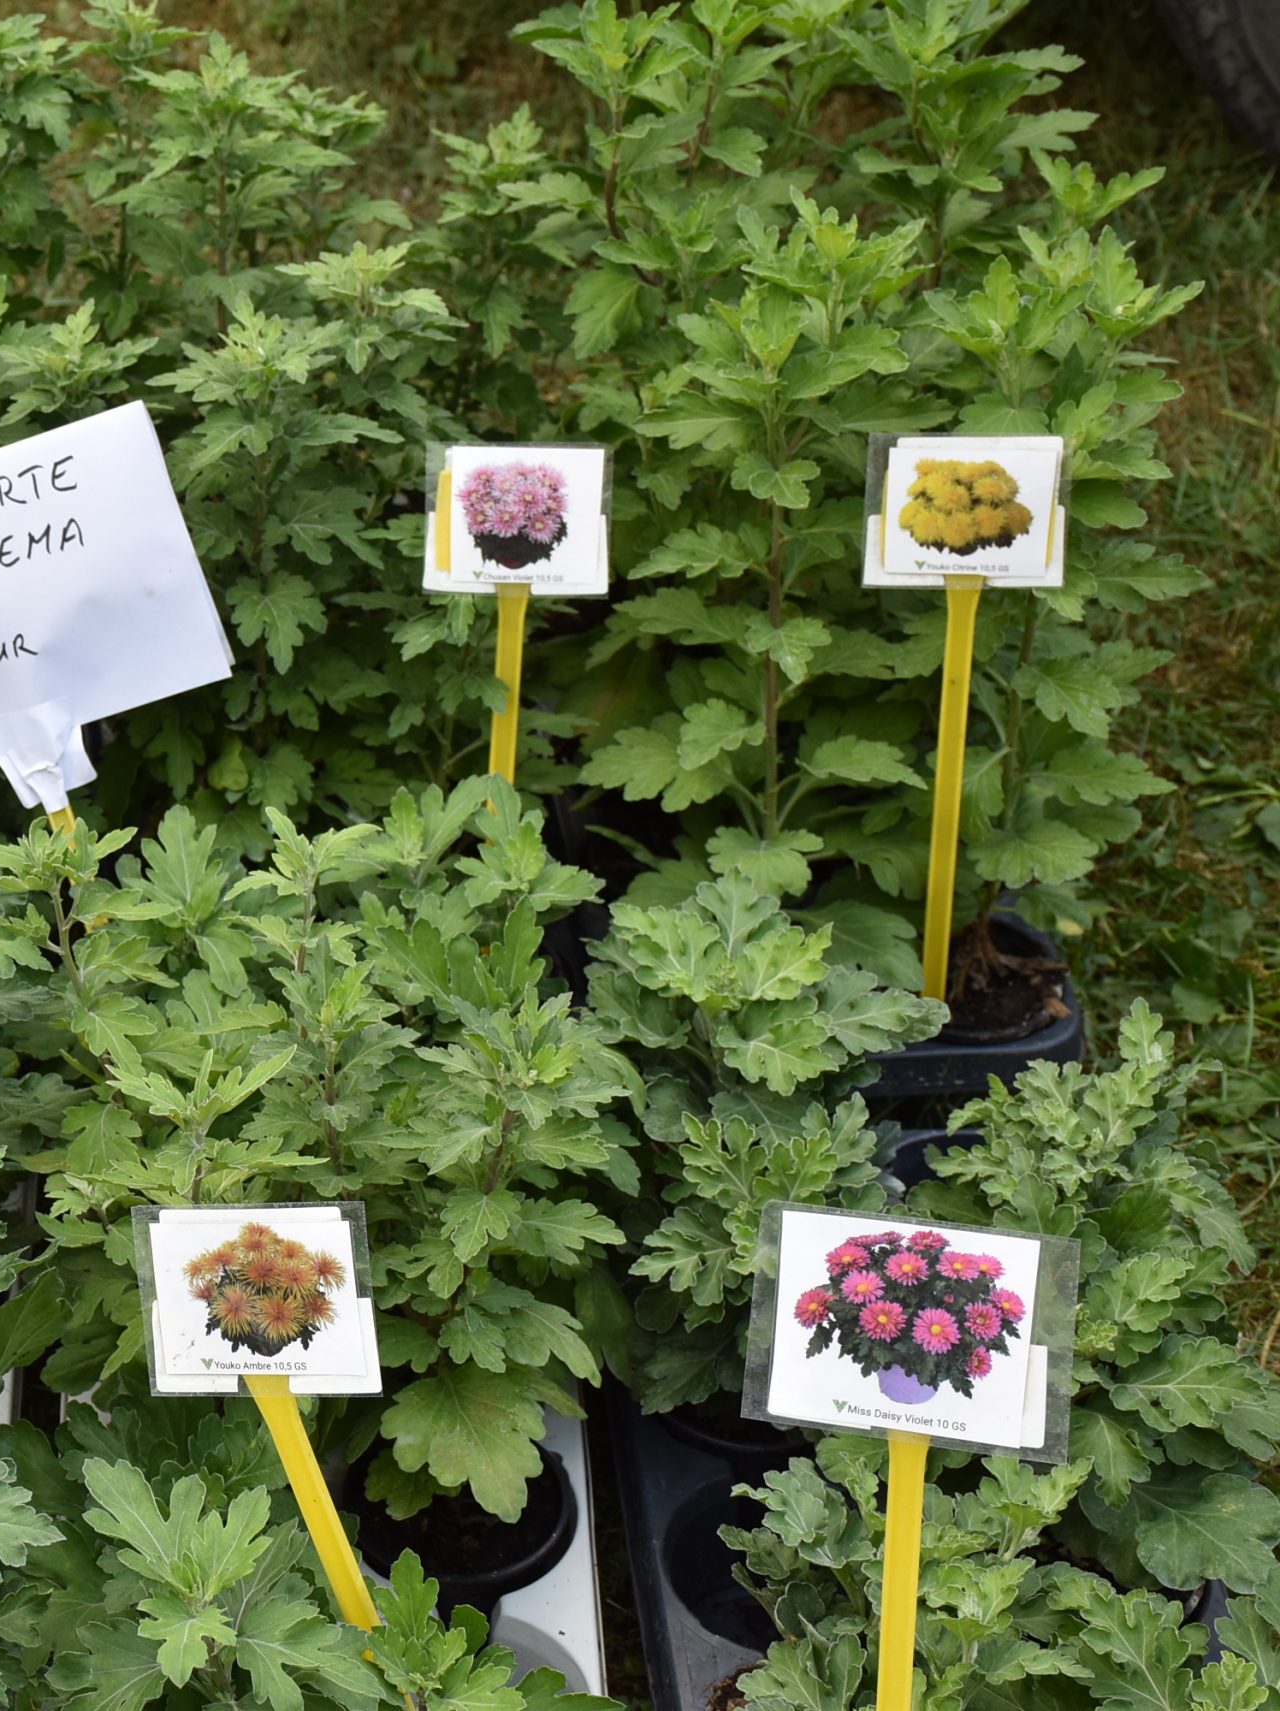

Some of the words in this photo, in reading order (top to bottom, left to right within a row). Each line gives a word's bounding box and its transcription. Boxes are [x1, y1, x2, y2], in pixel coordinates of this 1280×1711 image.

[998, 565, 1010, 573] GS
[214, 1361, 241, 1370] Youko
[243, 1361, 272, 1370] Ambre
[274, 1361, 292, 1372] 10,5
[294, 1362, 307, 1371] GS
[848, 1405, 872, 1417] Miss
[874, 1409, 902, 1424] Daisy
[904, 1413, 934, 1428] Violet
[937, 1419, 949, 1429] 10
[951, 1421, 967, 1432] GS
